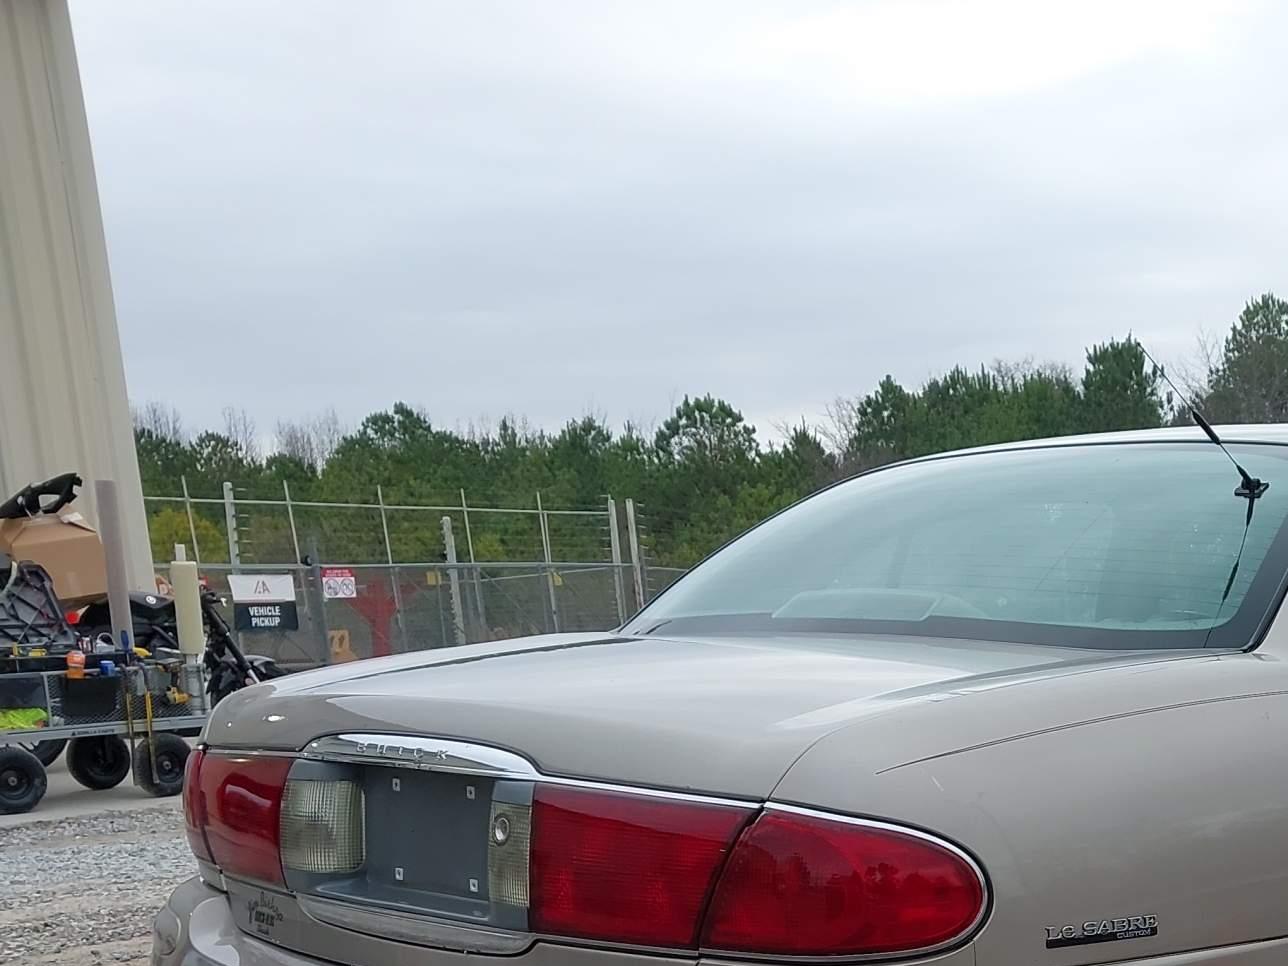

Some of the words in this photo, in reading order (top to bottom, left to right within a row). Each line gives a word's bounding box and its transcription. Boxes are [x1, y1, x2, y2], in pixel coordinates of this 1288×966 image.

[248, 605, 281, 616] VEHICLE
[251, 616, 281, 627] PICKUP
[355, 742, 449, 760] BUICK
[1116, 928, 1152, 939] CUSTOM
